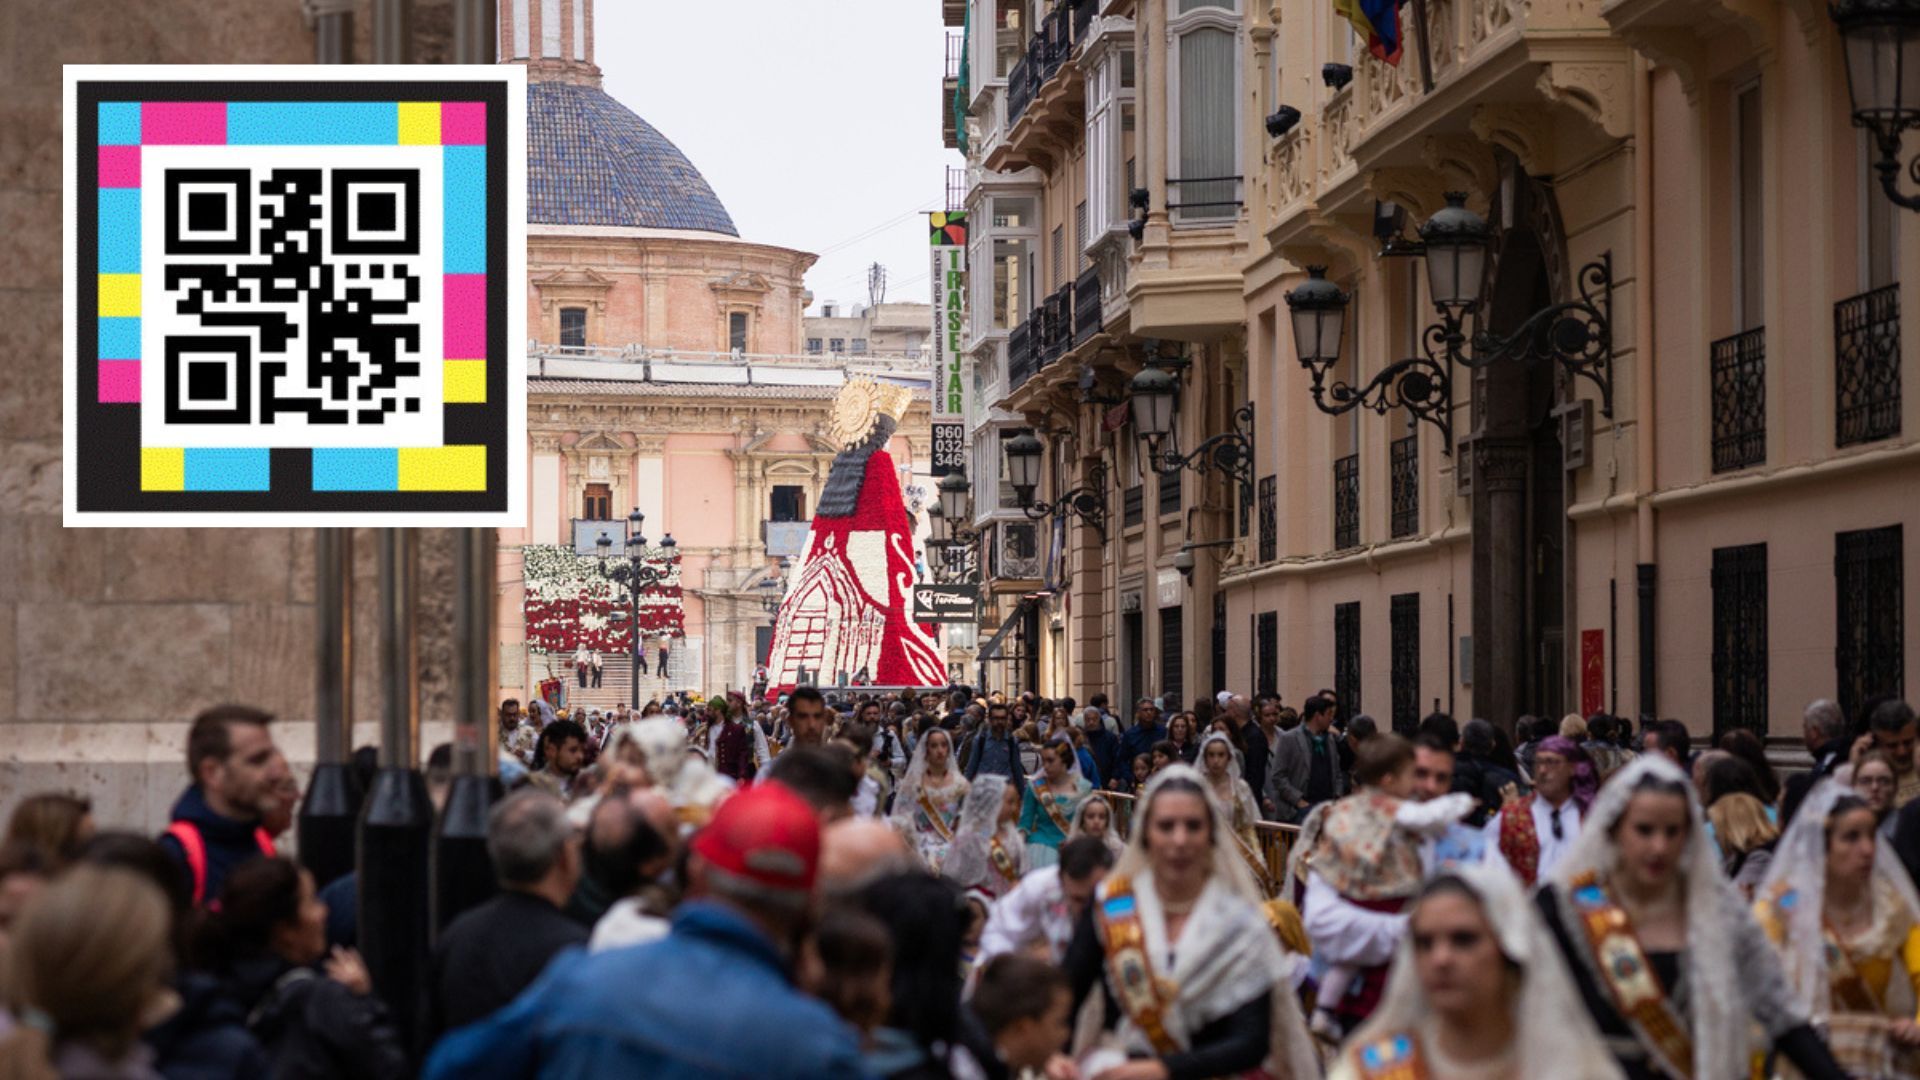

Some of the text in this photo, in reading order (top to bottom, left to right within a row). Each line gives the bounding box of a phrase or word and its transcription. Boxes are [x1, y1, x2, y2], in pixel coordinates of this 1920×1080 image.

[934, 282, 942, 303] MEDIO
[947, 249, 963, 413] TRASEJAR
[935, 425, 962, 439] 960
[935, 439, 962, 453] 032
[935, 453, 962, 467] 346
